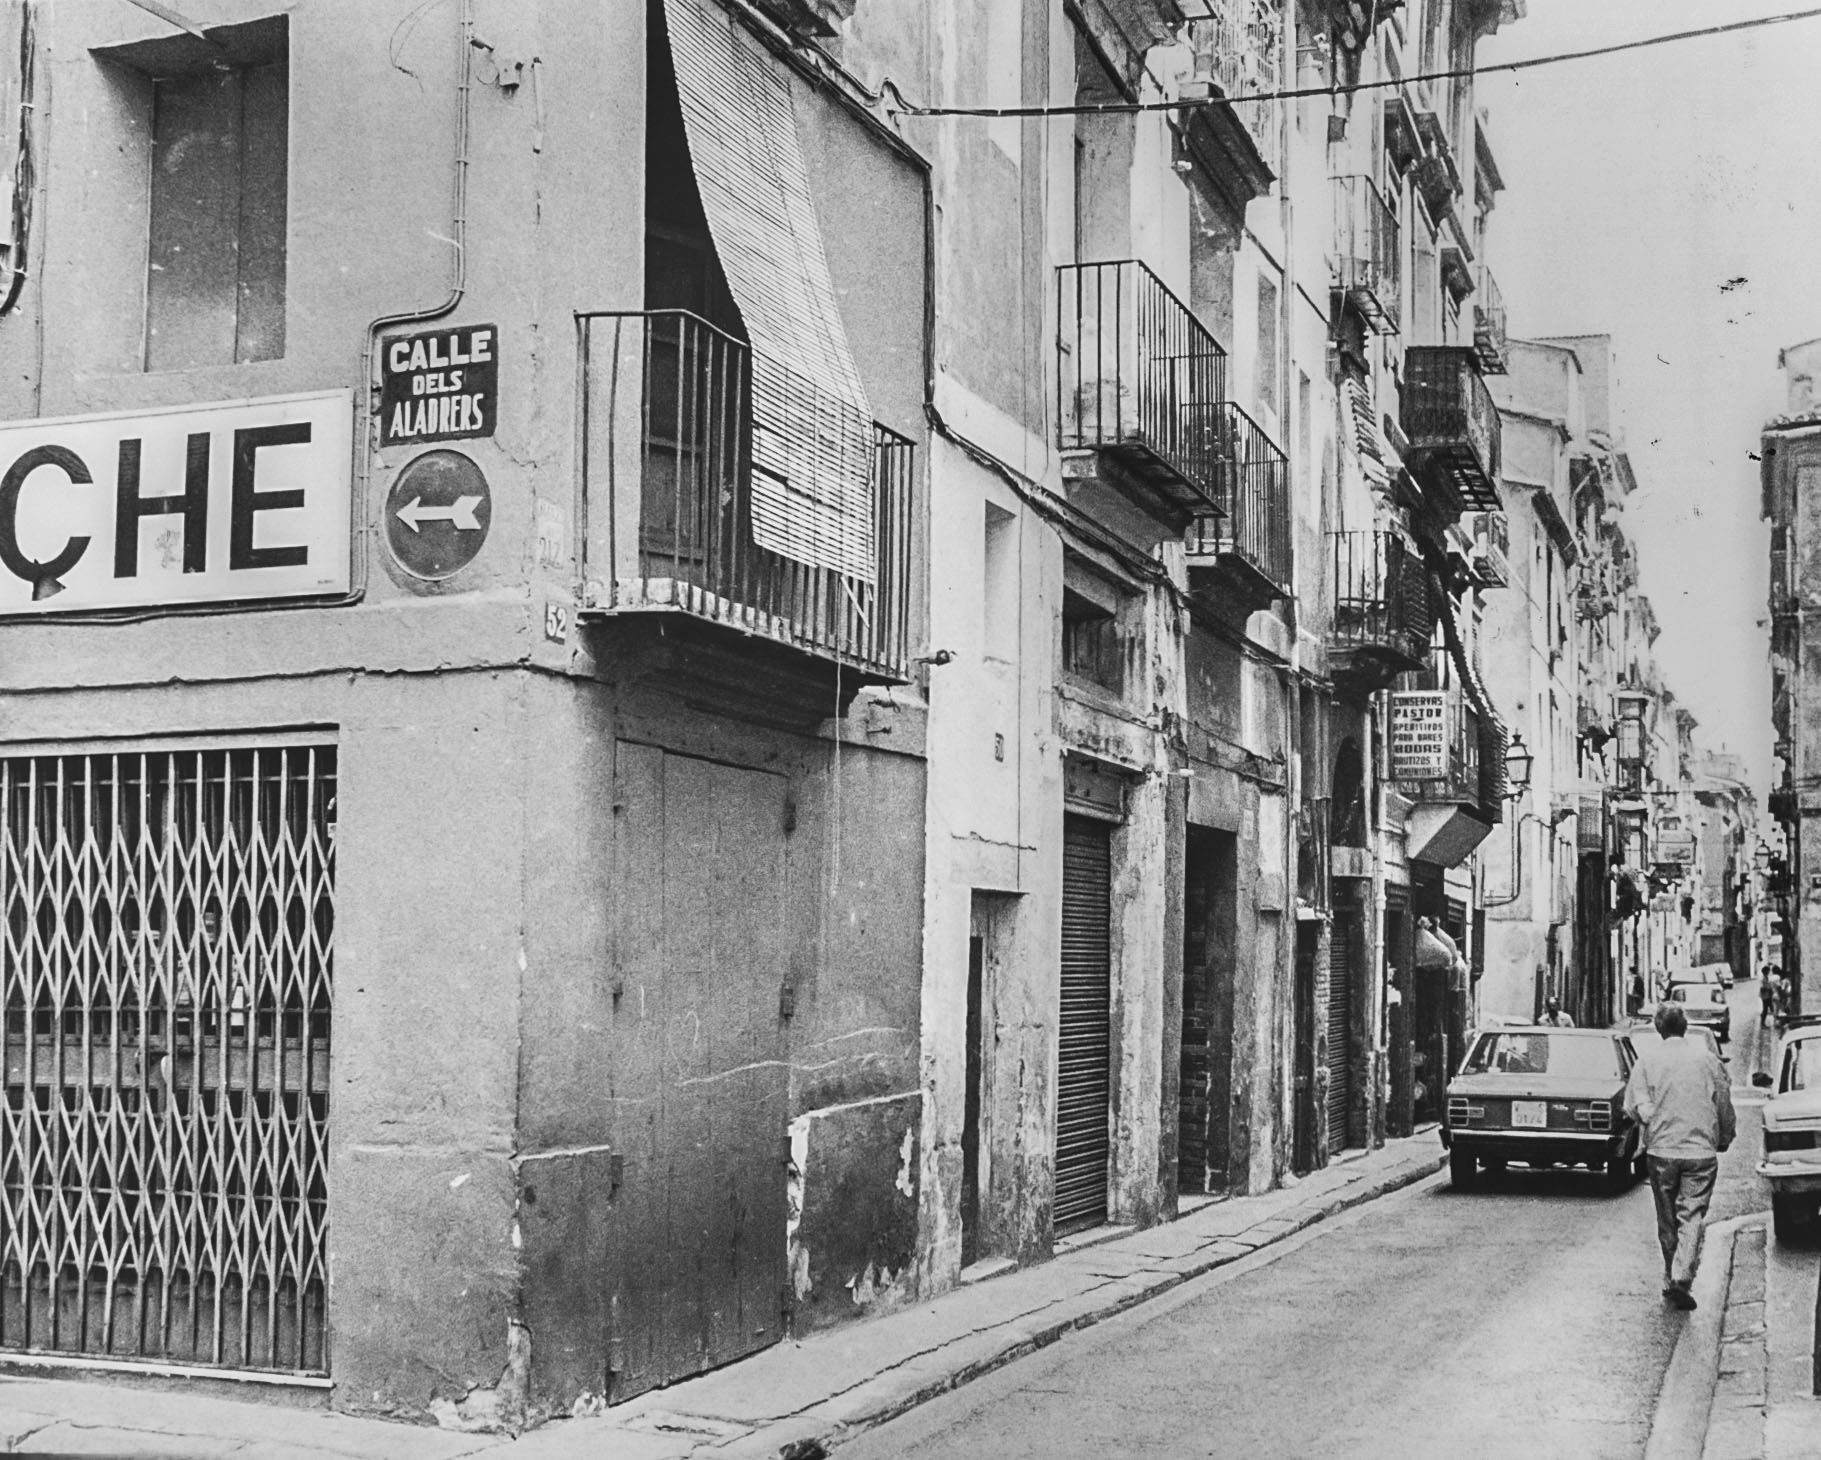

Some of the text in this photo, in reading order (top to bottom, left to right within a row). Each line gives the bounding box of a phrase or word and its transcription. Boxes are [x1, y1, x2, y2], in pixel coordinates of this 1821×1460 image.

[389, 330, 492, 372] CALLE
[412, 370, 464, 395] DELS
[389, 393, 484, 438] ALADRERS
[546, 605, 566, 638] 52
[1393, 696, 1443, 706] CONSERVAS
[1394, 708, 1442, 718] PASTOR
[1393, 723, 1443, 731] APERITIVOS
[1394, 744, 1442, 753] BODAS
[1436, 756, 1442, 765] Y
